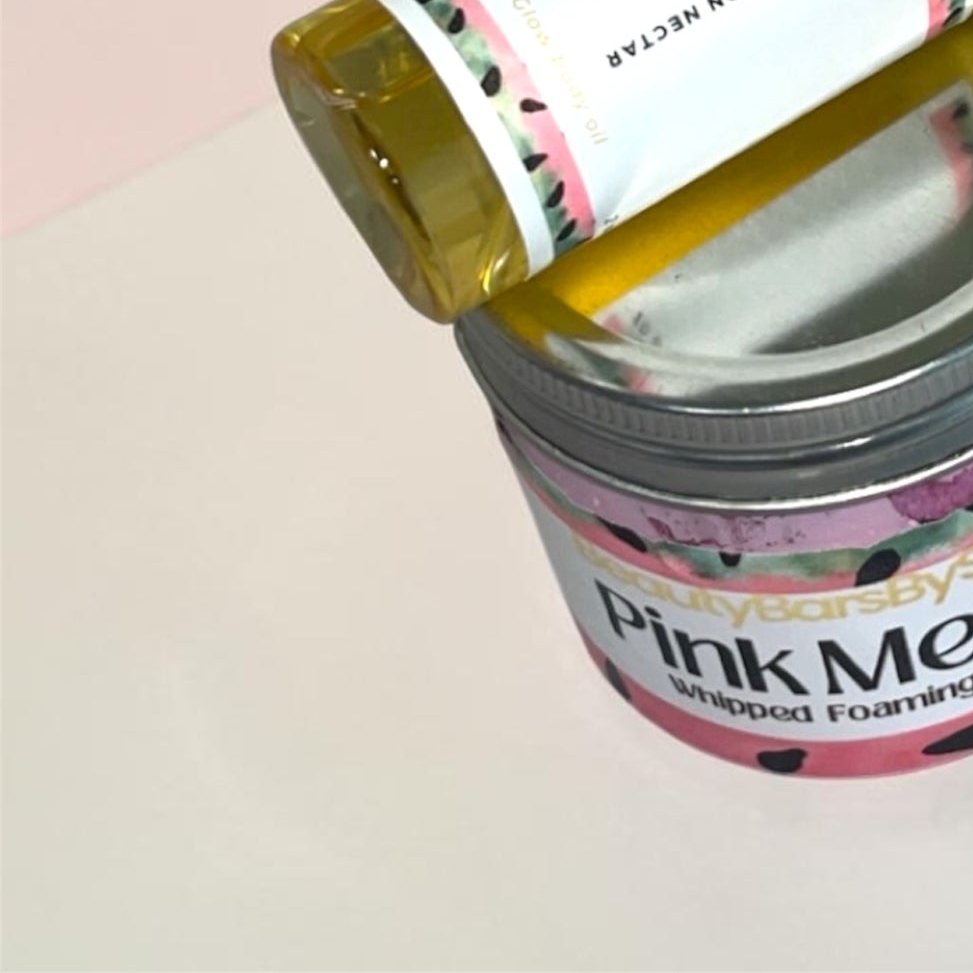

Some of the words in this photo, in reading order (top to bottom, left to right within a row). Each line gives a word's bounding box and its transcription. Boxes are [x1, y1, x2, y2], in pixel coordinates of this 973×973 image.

[605, 4, 701, 68] NECTAR
[585, 118, 608, 145] oil
[594, 578, 811, 696] Pink
[668, 673, 814, 723] Whipped
